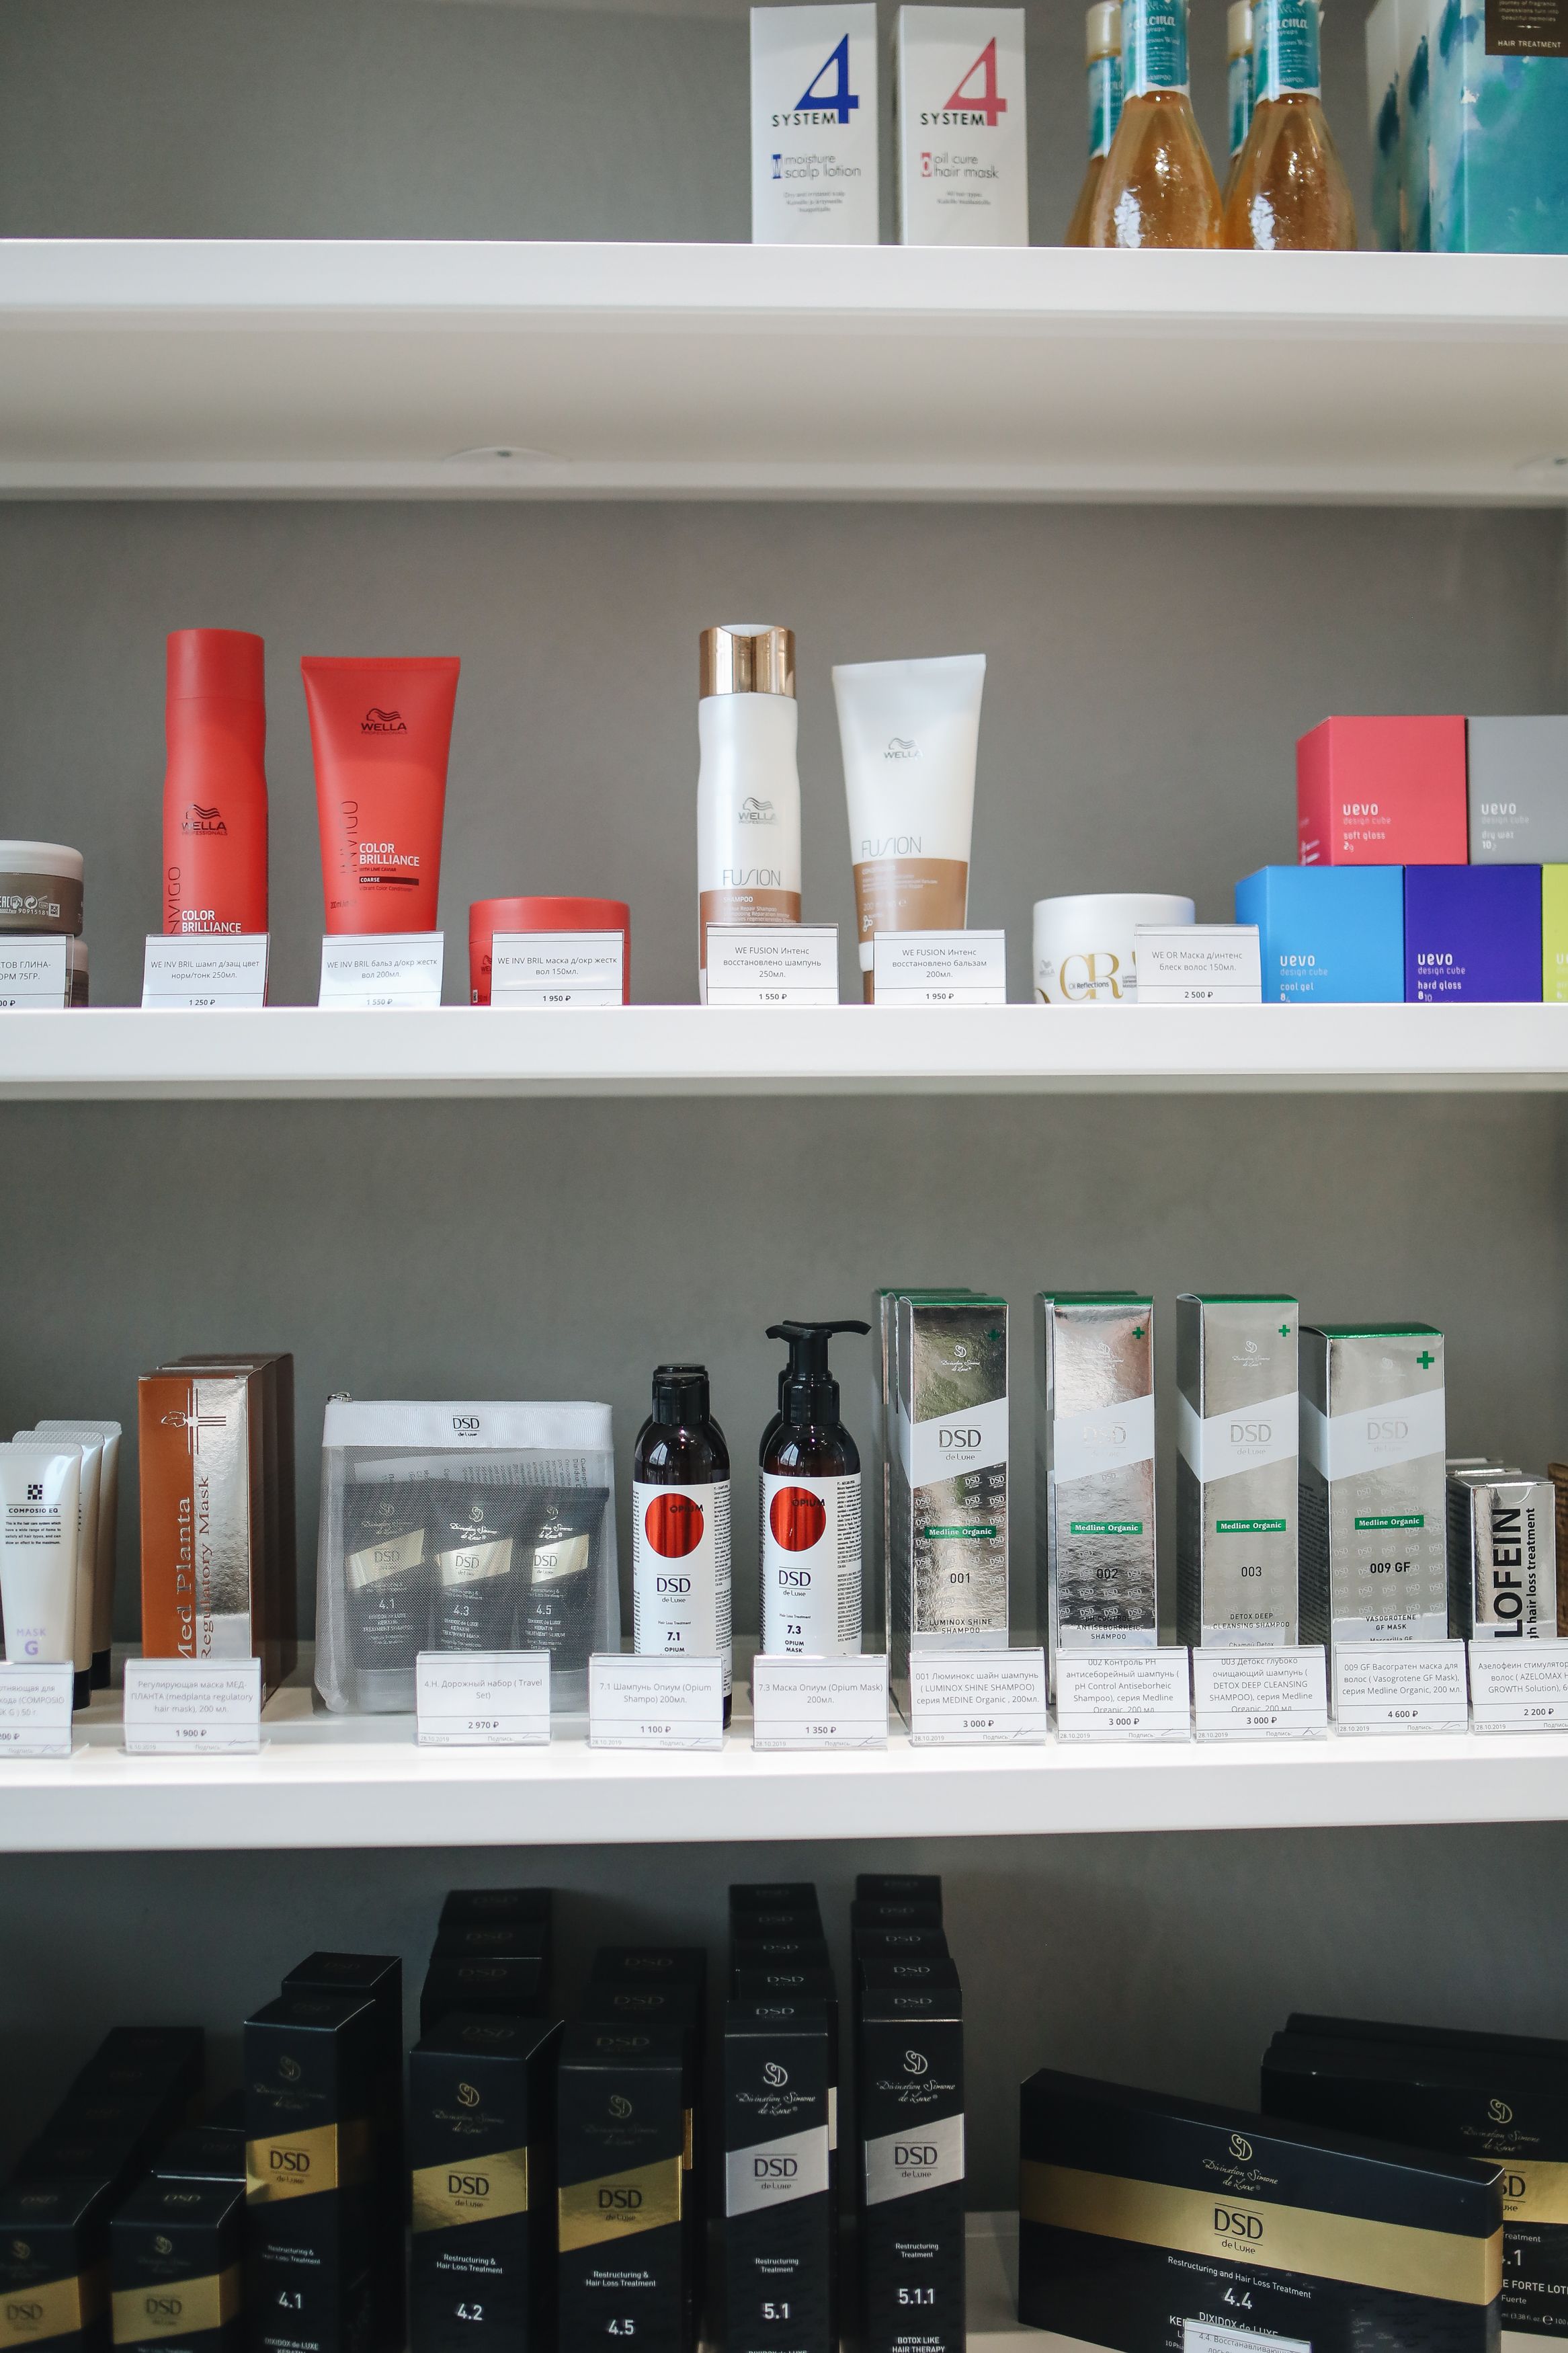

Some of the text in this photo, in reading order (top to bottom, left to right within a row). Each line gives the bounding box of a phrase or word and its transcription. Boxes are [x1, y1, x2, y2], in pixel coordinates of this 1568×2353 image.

[772, 113, 835, 126] SYSTEM
[921, 113, 984, 126] SYSTEM
[784, 154, 835, 164] moisture
[935, 153, 979, 165] oil cure
[784, 163, 861, 180] scalp lotion
[934, 165, 999, 179] hair mask
[361, 723, 407, 731] WELLA
[1343, 804, 1378, 815] uevo
[739, 812, 776, 820] WELLA
[182, 822, 227, 832] WELLA
[1344, 831, 1385, 841] soft gloss
[360, 843, 395, 853] COLOR
[862, 836, 921, 856] FUSION
[360, 854, 419, 867] BRILLIANCE
[723, 869, 780, 886] FUSION
[18, 908, 48, 916] 90915181
[182, 910, 215, 920] COLOR
[182, 922, 241, 932] BRILLIANCE
[1206, 952, 1242, 960] д/интенс
[1280, 955, 1315, 966] uevo
[1418, 953, 1452, 965] uevo
[172, 972, 210, 980] норм/тонк
[1418, 966, 1466, 975] design cube
[1077, 981, 1109, 989] Reflections
[1280, 983, 1314, 992] cool gel
[1418, 980, 1462, 991] hard gloss
[452, 1417, 480, 1429] DSD
[940, 1430, 981, 1447] DSD
[199, 1475, 210, 1536] Mask
[792, 1499, 825, 1507] OPIUM
[1391, 1518, 1419, 1526] Organic
[962, 1528, 992, 1536] Organic
[176, 1497, 192, 1595] Planta
[1241, 1566, 1262, 1577] 003
[1370, 1562, 1410, 1574] 009 GF
[1526, 1508, 1536, 1624] hair loss treatment
[779, 1570, 811, 1586] DSD
[950, 1572, 971, 1584] 001
[1493, 1508, 1523, 1638] LOFEIN
[1366, 1614, 1416, 1622] VASOGROTENE
[17, 1628, 46, 1636] MASK
[788, 1625, 801, 1634] 7.3
[667, 1632, 679, 1641] 7.1
[1373, 1664, 1417, 1672] Васогратен
[800, 1684, 827, 1693] Опиум
[829, 1684, 858, 1693] (Opium
[860, 1683, 882, 1692] Mask)
[1075, 1683, 1085, 1691] pH
[1400, 1687, 1431, 1696] Organic,
[895, 2147, 938, 2165] DSD
[754, 2159, 798, 2177] DSD
[448, 2176, 489, 2196] DSD
[1213, 2208, 1263, 2240] DSD
[755, 2258, 798, 2266] Restructuring
[1167, 2256, 1311, 2299] Restructuring and Hair Loss Treatment
[279, 2292, 302, 2309] 4.1
[898, 2288, 935, 2305] 5.1.1
[1224, 2288, 1253, 2310] 4.4
[457, 2304, 483, 2321] 4.2
[764, 2303, 790, 2319] 5.1
[608, 2319, 634, 2335] 4.5
